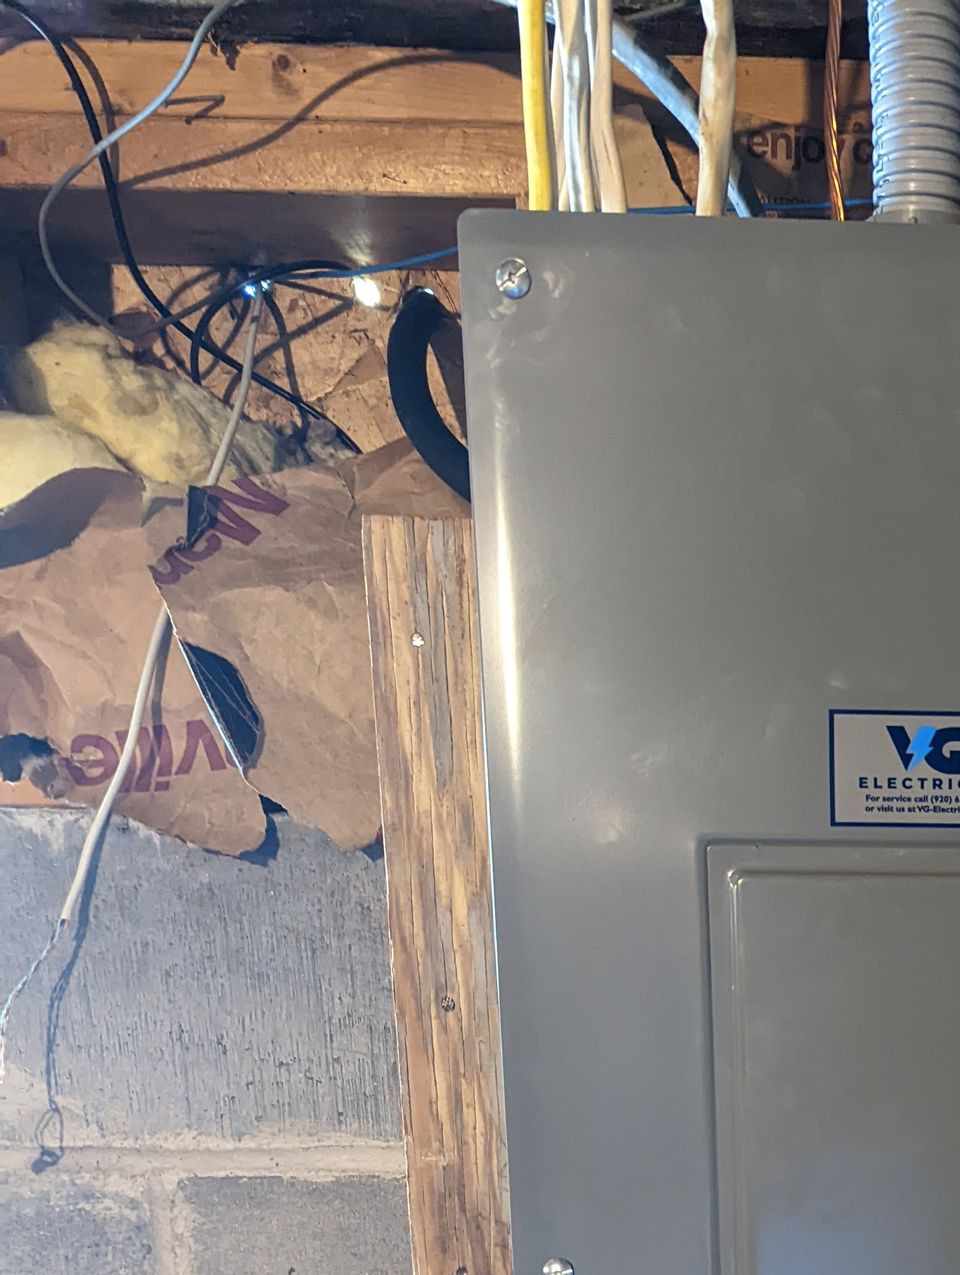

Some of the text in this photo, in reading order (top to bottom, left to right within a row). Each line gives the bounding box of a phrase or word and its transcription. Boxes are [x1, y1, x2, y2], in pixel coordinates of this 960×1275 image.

[882, 795, 912, 803] service
[914, 795, 928, 803] call
[930, 795, 952, 804] (920)
[877, 805, 894, 813] visit
[907, 805, 916, 813] at
